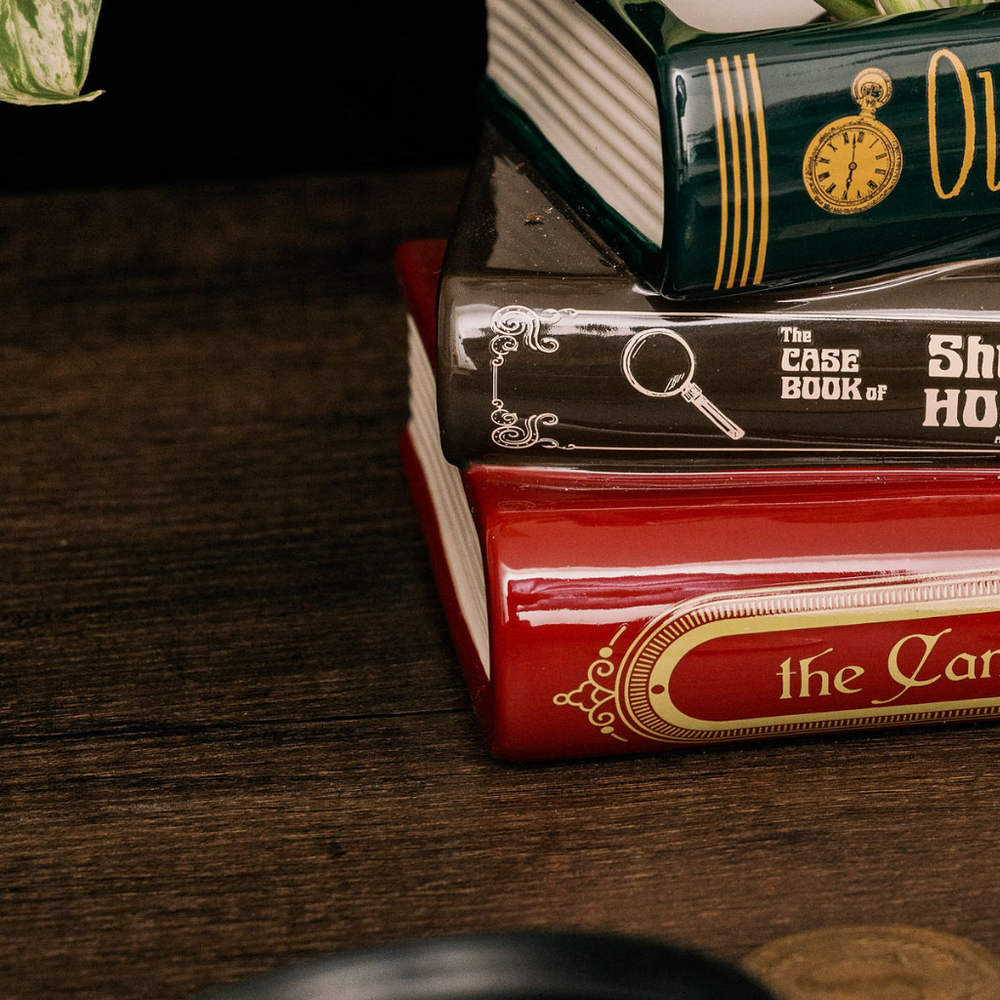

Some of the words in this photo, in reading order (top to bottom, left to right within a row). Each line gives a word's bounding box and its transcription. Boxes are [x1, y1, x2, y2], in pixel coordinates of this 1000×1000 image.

[778, 326, 812, 343] The
[780, 347, 860, 373] CASE
[780, 376, 863, 401] BOOK
[865, 384, 888, 401] of
[776, 647, 865, 699] the
